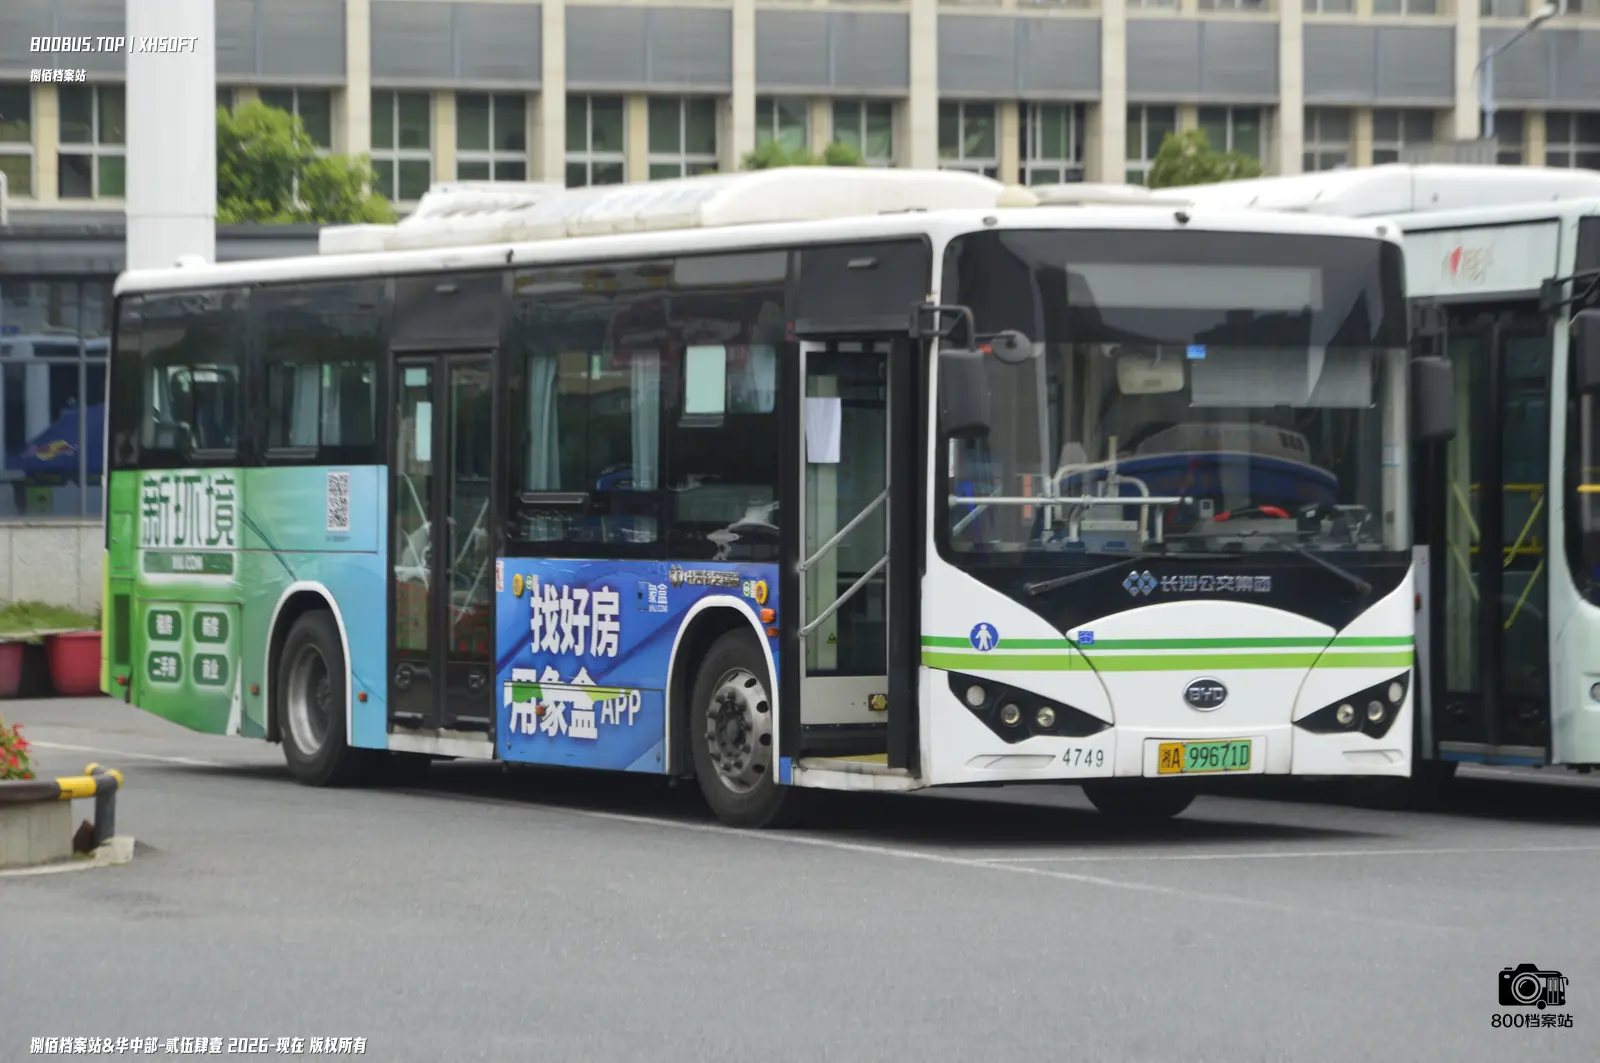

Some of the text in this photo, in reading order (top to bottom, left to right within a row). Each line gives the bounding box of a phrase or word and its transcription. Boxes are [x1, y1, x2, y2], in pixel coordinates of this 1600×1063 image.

[143, 473, 235, 546] 新环境
[530, 584, 621, 657] 找好房
[1188, 687, 1224, 701] BYD
[1062, 748, 1104, 768] 4749
